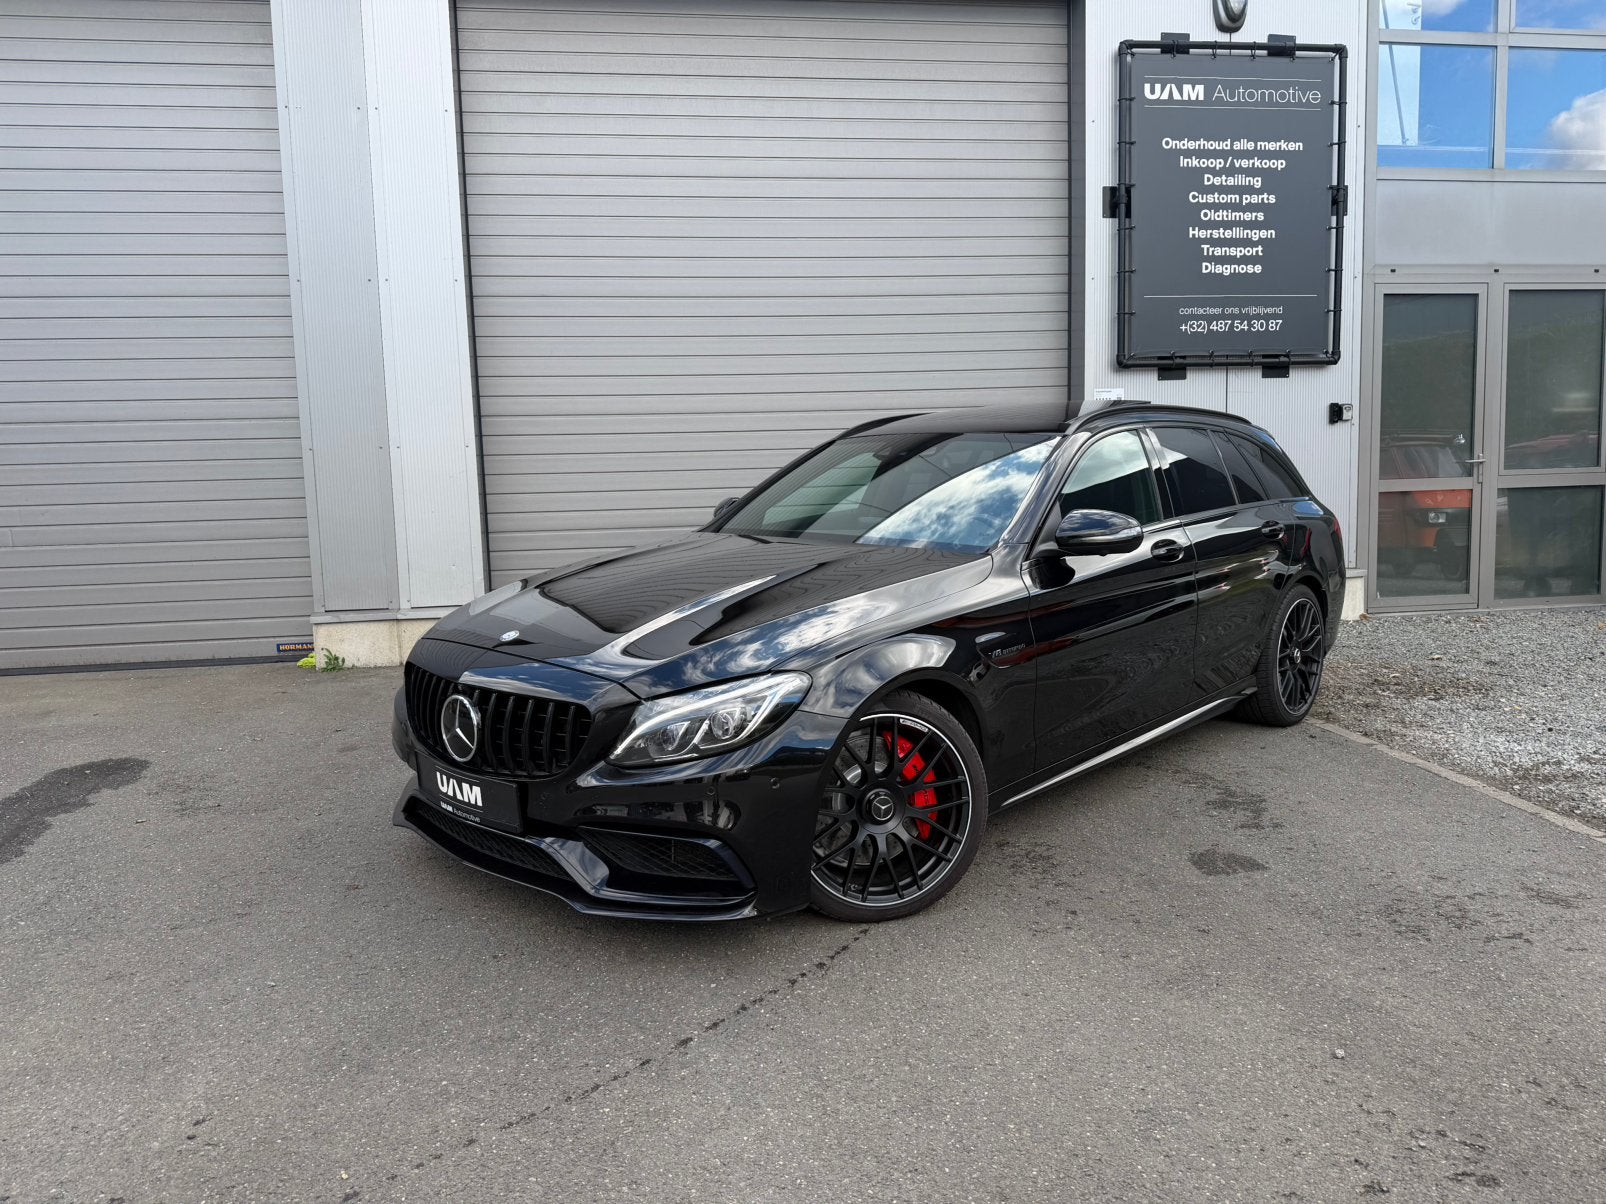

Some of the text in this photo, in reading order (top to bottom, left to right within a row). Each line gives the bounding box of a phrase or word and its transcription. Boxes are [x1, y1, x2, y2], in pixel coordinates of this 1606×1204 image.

[1143, 83, 1322, 104] UAM Automotive
[1161, 137, 1303, 151] Onderhoud alle merken
[1179, 156, 1286, 171] Inkoop / verkoop
[1203, 173, 1262, 188] Detailing
[1188, 191, 1276, 206] Custom parts
[1200, 209, 1265, 222] Oldtimers
[1188, 226, 1276, 242] Herstellingen
[1200, 244, 1263, 260] Transport
[1201, 262, 1262, 276] Diagnose
[1179, 305, 1283, 316] contacteer ons vrijblijvend
[1179, 320, 1283, 335] +(32) 487 54 30 87
[436, 771, 483, 807] UAM
[453, 808, 481, 823] Automotive
